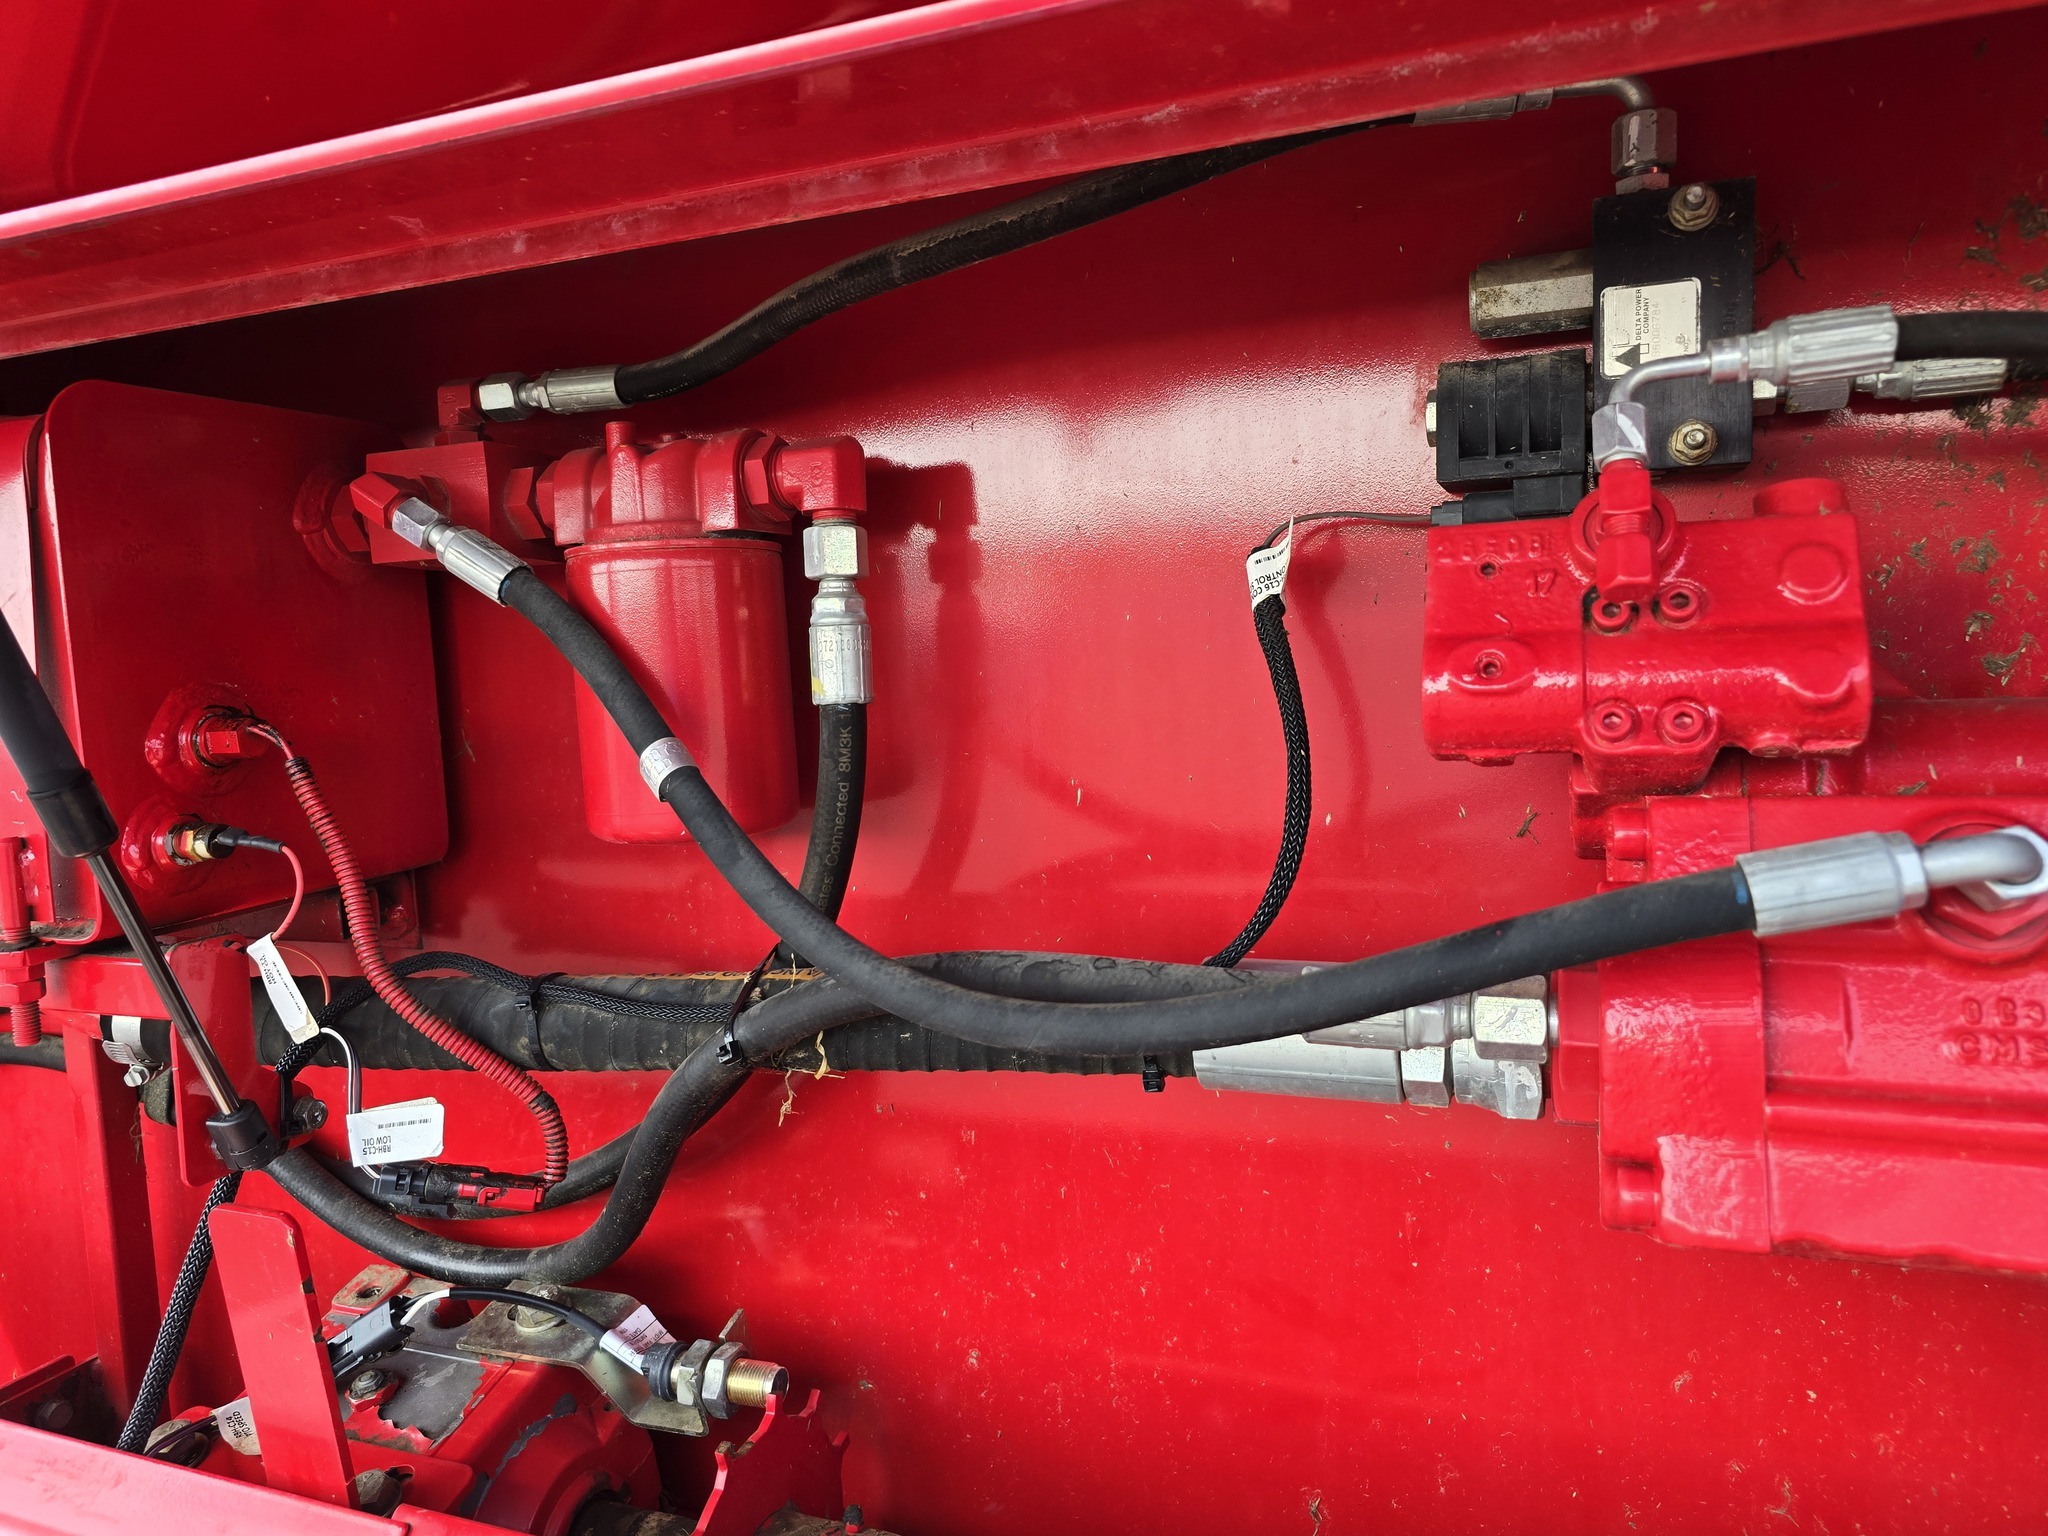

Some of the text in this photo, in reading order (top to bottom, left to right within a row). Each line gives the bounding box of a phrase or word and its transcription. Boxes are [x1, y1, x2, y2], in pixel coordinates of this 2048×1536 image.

[1642, 297, 1650, 334] COMPANY
[1255, 565, 1287, 585] ONTROL
[838, 726, 852, 773] 8M3K
[361, 1135, 392, 1146] LOW OIL
[362, 1144, 392, 1156] RBH-C15
[232, 1410, 248, 1428] SPEED
